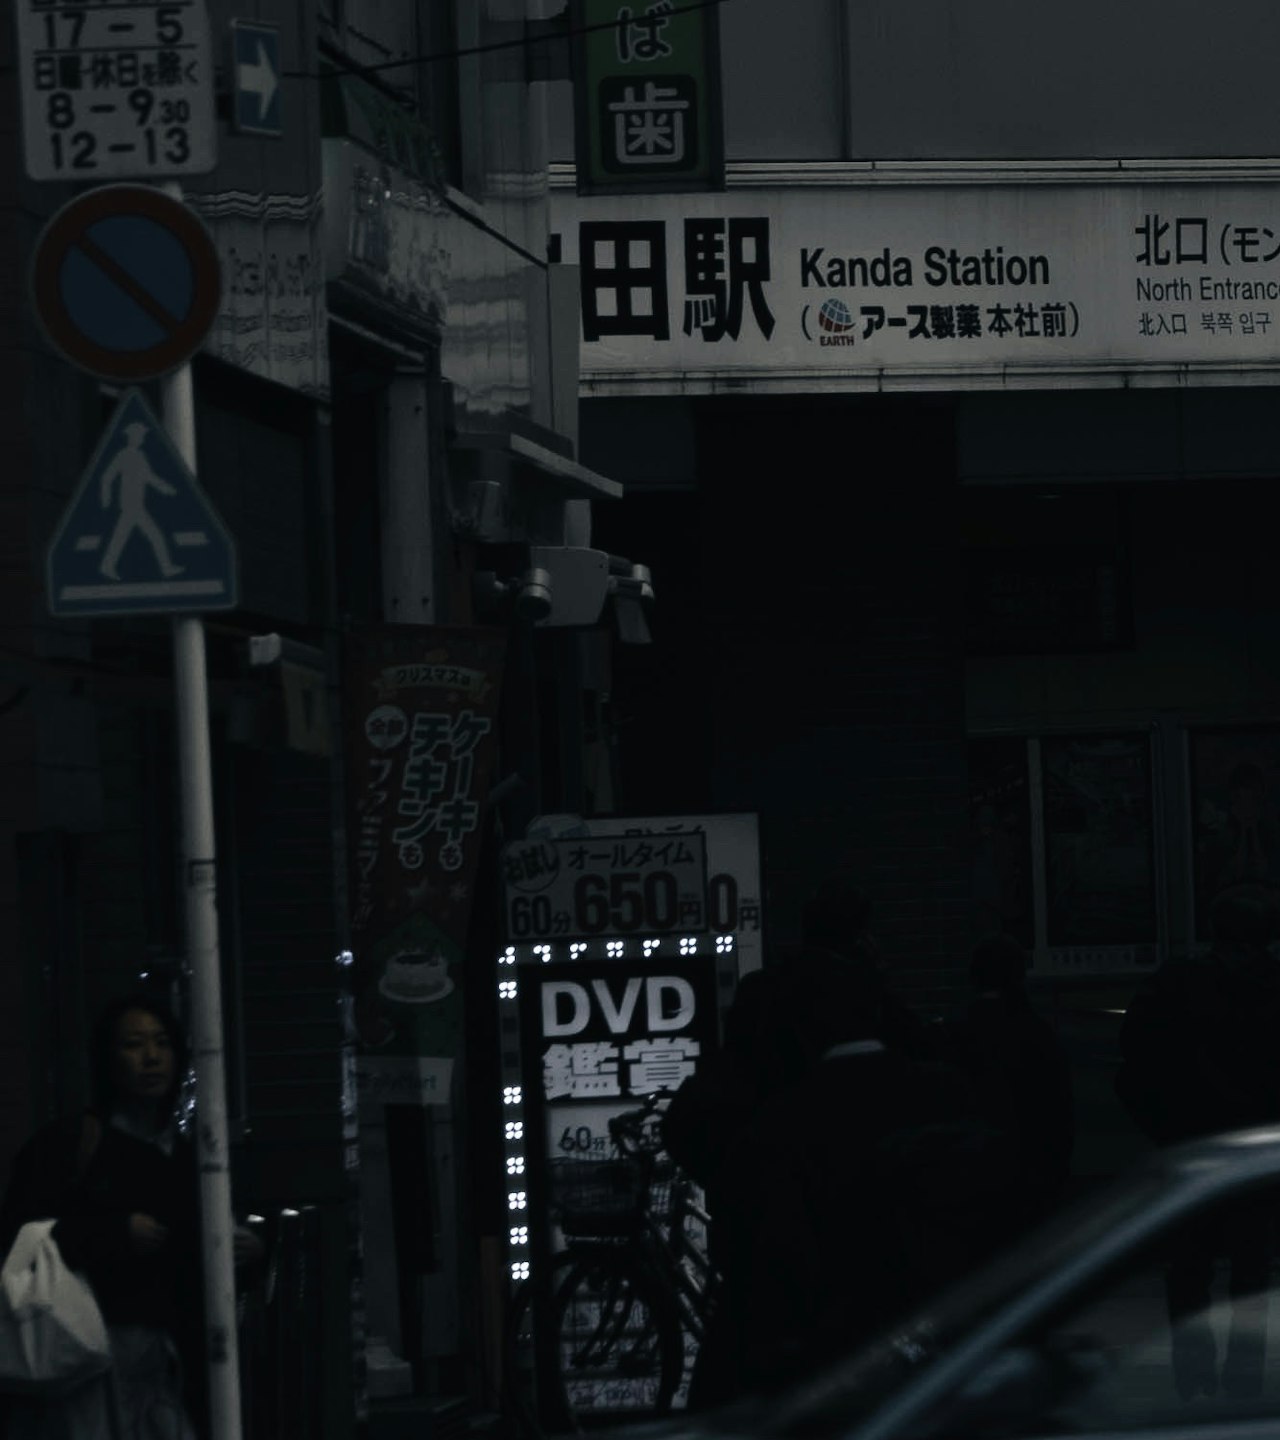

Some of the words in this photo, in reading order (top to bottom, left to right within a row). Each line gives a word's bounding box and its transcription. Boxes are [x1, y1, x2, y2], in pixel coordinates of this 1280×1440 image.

[608, 81, 689, 165] 歯
[801, 247, 912, 288] Kanda
[924, 246, 1051, 287] Station
[1136, 276, 1193, 302] North
[1138, 313, 1187, 337] 北入口
[1238, 311, 1272, 335] 입구
[819, 335, 855, 347] EARTH
[567, 841, 695, 870] オールタイム
[540, 974, 697, 1038] DVD
